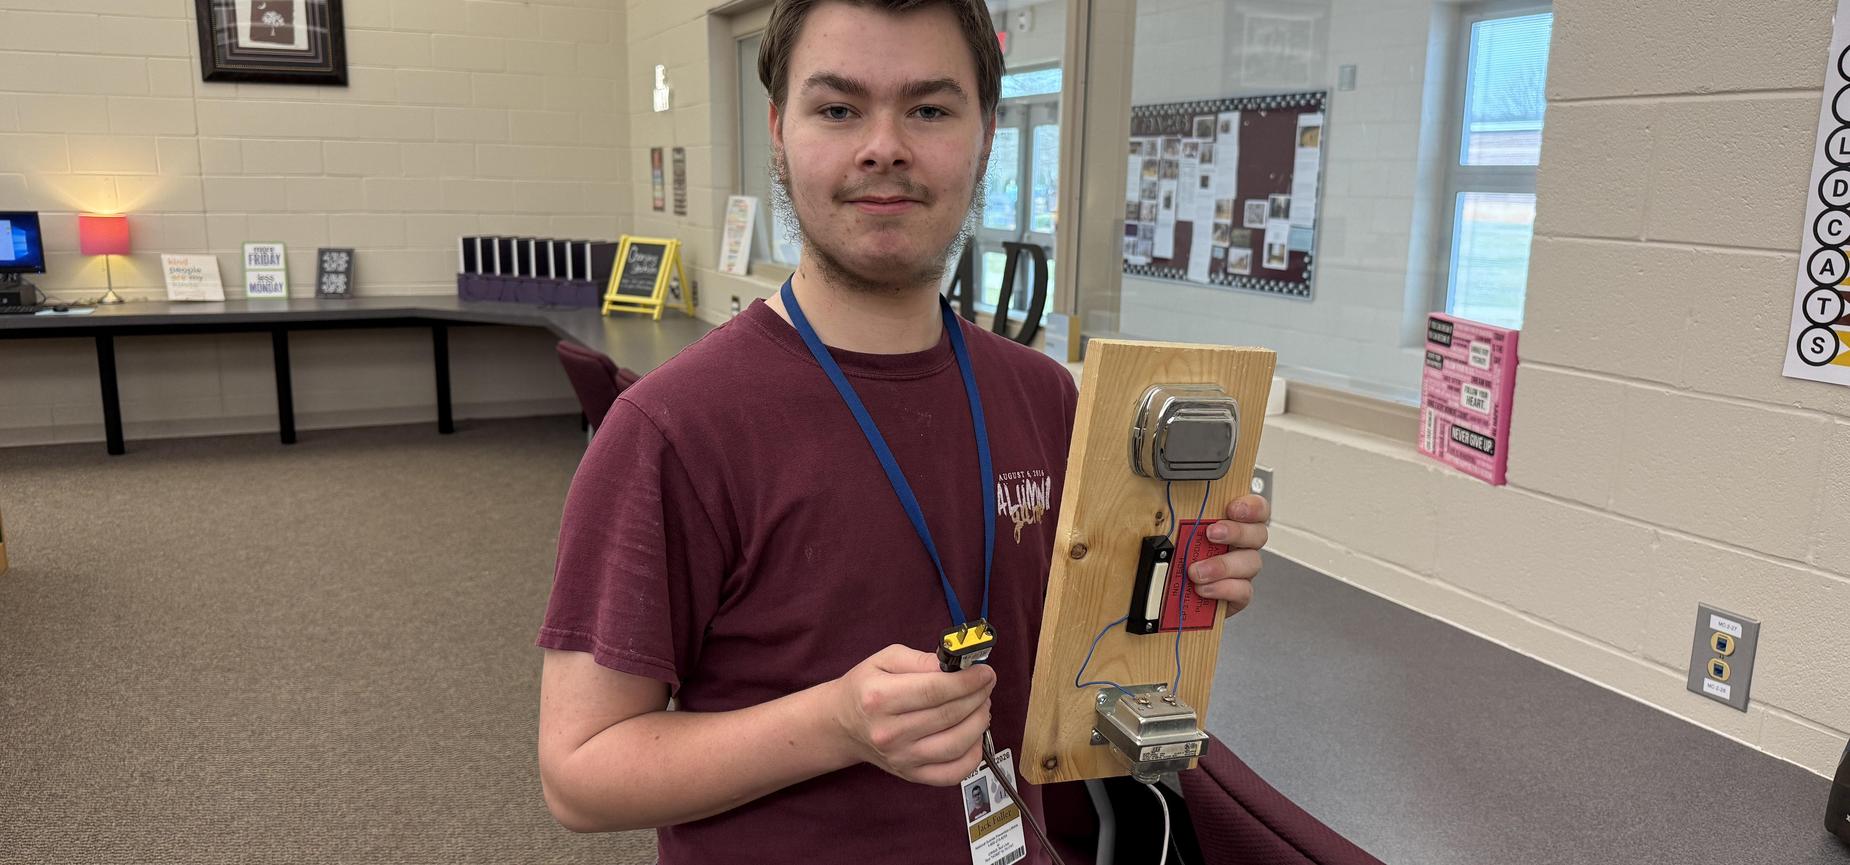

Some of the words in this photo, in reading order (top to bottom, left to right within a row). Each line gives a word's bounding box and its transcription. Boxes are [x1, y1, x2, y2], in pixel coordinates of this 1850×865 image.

[248, 254, 281, 265] FRIDAY
[169, 267, 202, 275] people
[249, 282, 282, 293] MONDAY
[1464, 385, 1478, 396] FOLLOW
[1479, 389, 1488, 399] YOUR
[1466, 395, 1486, 410] HEART.
[1452, 426, 1470, 445] NEVER
[1470, 433, 1483, 450] GIVE
[1483, 438, 1493, 455] UP.
[999, 471, 1025, 481] AUGUST
[997, 476, 1051, 516] ALUMNI
[977, 820, 991, 836] Jack
